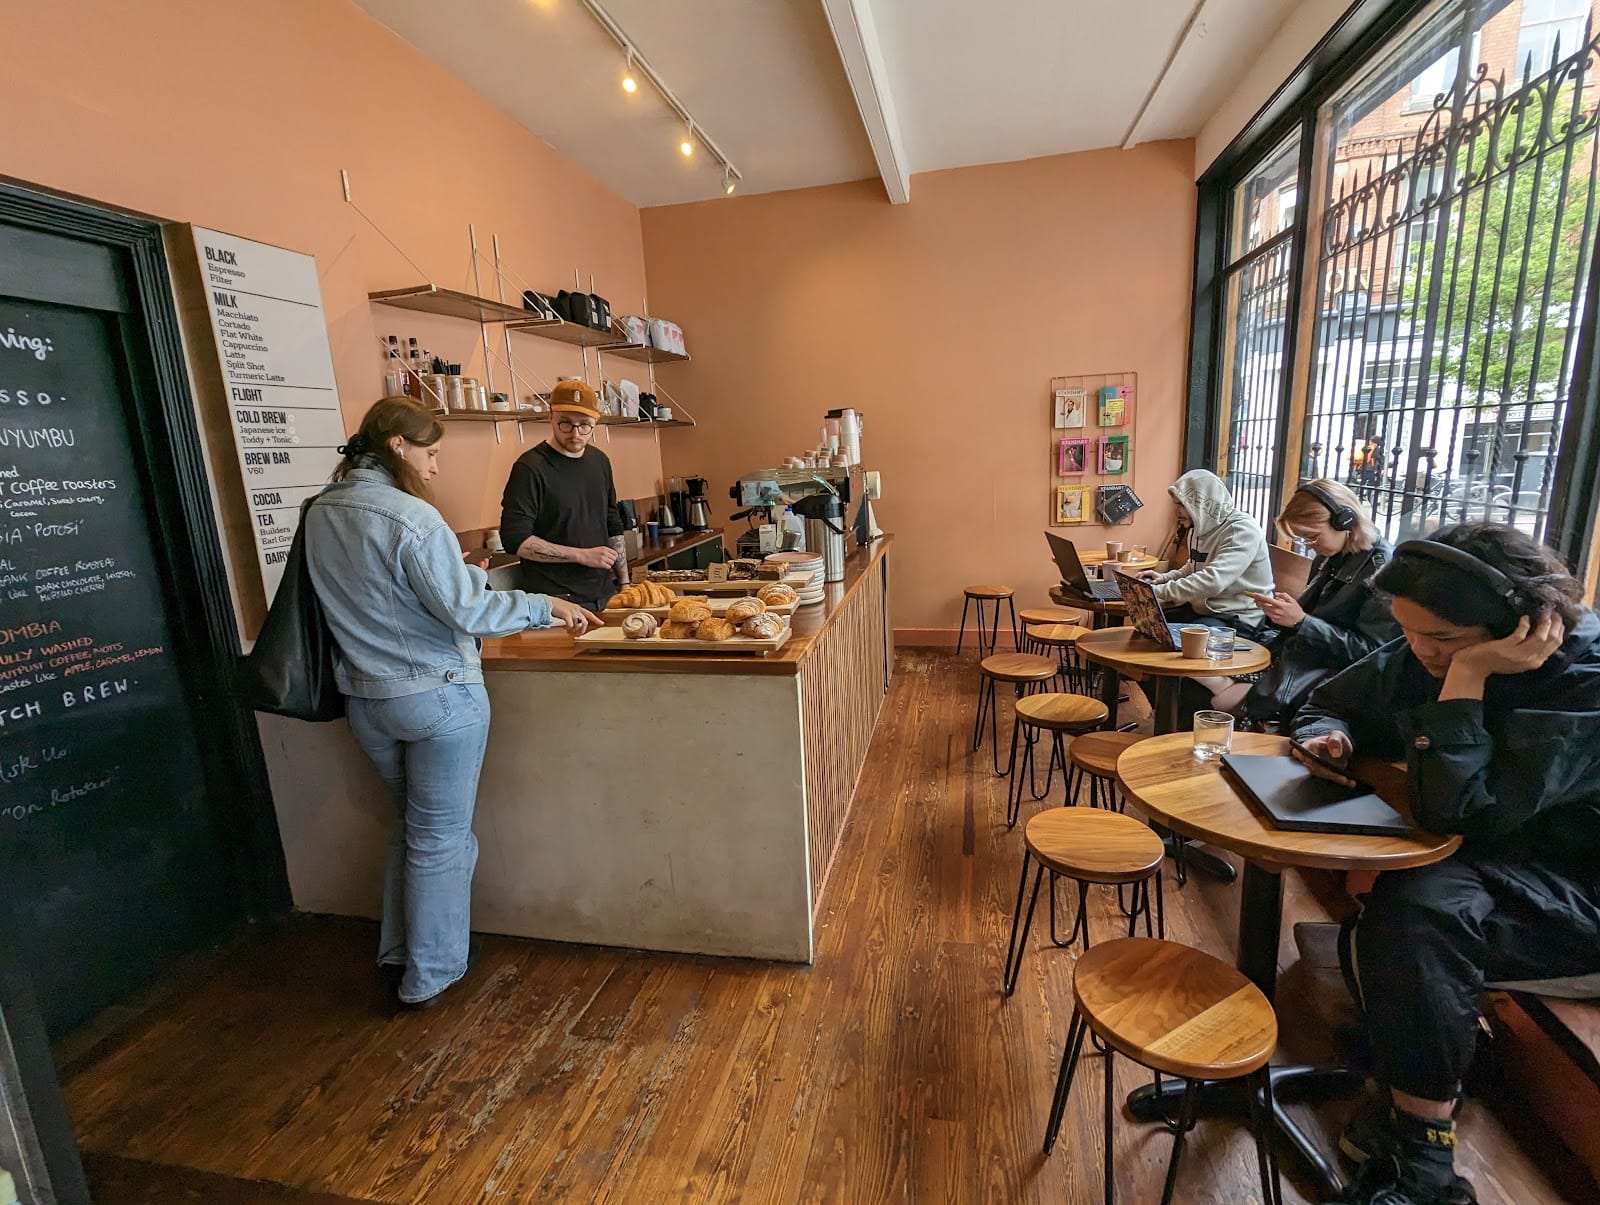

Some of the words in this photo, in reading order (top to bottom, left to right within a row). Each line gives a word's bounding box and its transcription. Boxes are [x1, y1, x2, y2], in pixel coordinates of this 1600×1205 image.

[204, 246, 238, 266] BLACK
[207, 263, 246, 279] Espresso
[209, 273, 233, 285] Filter
[213, 291, 239, 309] MILK
[216, 308, 259, 322] Macchiato
[218, 319, 251, 331] Cortado
[220, 329, 238, 339] Flat
[238, 331, 264, 343] White
[222, 339, 269, 353] Cappuccino
[224, 350, 246, 360] Latte
[226, 360, 245, 371] Split
[246, 361, 266, 371] Shot
[228, 370, 265, 382] Turmeric
[266, 373, 285, 382] Latte
[231, 387, 263, 402] FLIGHT
[236, 410, 260, 424] COLD
[262, 411, 287, 425] BREW
[240, 426, 273, 437] Japanese
[241, 435, 265, 446] Toddy
[272, 436, 292, 444] Tonic
[245, 452, 271, 466] BREW
[272, 451, 292, 465] BAR
[247, 467, 264, 475] V60
[62, 478, 117, 490] roasters
[252, 492, 283, 507] COCOA
[256, 514, 275, 527] TEA
[260, 527, 291, 537] Builders
[262, 536, 278, 546] Earl
[35, 566, 70, 580] COFFEE
[40, 636, 94, 655] WASHED
